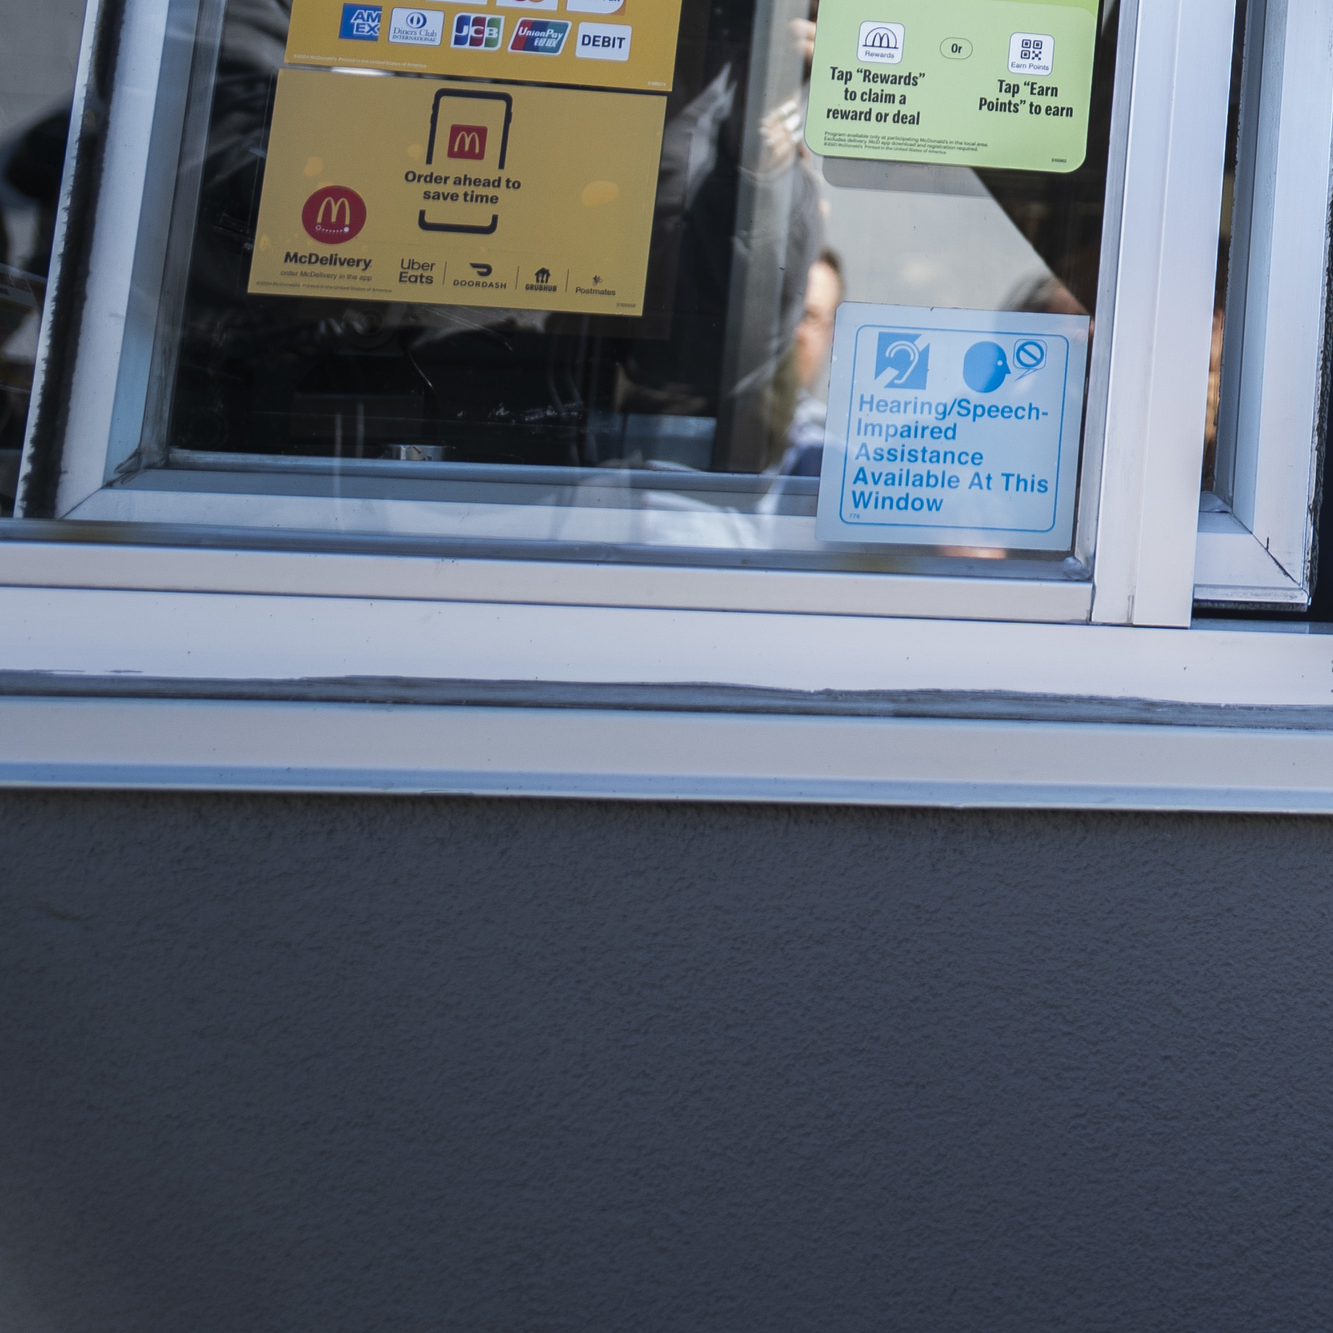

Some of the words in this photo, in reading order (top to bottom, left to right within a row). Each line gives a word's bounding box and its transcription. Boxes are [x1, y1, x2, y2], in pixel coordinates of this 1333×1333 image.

[351, 10, 382, 22] AM
[354, 22, 380, 36] EX
[394, 27, 418, 36] Diners
[419, 29, 438, 37] Club
[455, 25, 498, 38] JCB
[518, 26, 564, 40] UnionPay
[582, 34, 626, 48] DEBIT
[864, 50, 894, 60] Rewards
[951, 42, 962, 54] Or
[1028, 62, 1050, 71] Points
[829, 67, 852, 84] Tap
[844, 87, 858, 102] to
[860, 86, 896, 104] claim
[898, 94, 907, 105] a
[998, 79, 1020, 97] Tap
[826, 107, 872, 122] reward
[875, 111, 890, 122] or
[892, 110, 920, 126] deal
[1028, 101, 1042, 115] to
[1044, 105, 1074, 118] earn
[404, 170, 450, 184] Order
[453, 174, 502, 188] ahead
[505, 178, 521, 190] to
[423, 190, 460, 202] save
[463, 190, 499, 204] time
[284, 252, 372, 271] McDelivery
[400, 258, 436, 272] Uber
[300, 271, 338, 280] McDelivery
[398, 271, 434, 285] Eats
[453, 279, 507, 290] DOORDASH
[525, 283, 558, 292] GRUBHUB
[576, 286, 616, 296] Postmates
[858, 394, 1048, 422] Hearing/Speech-
[856, 418, 957, 442] Impaired
[854, 442, 984, 466] Assistance
[852, 466, 960, 490] Available
[968, 471, 992, 490] At
[1001, 472, 1048, 494] This
[852, 490, 944, 512] Window
